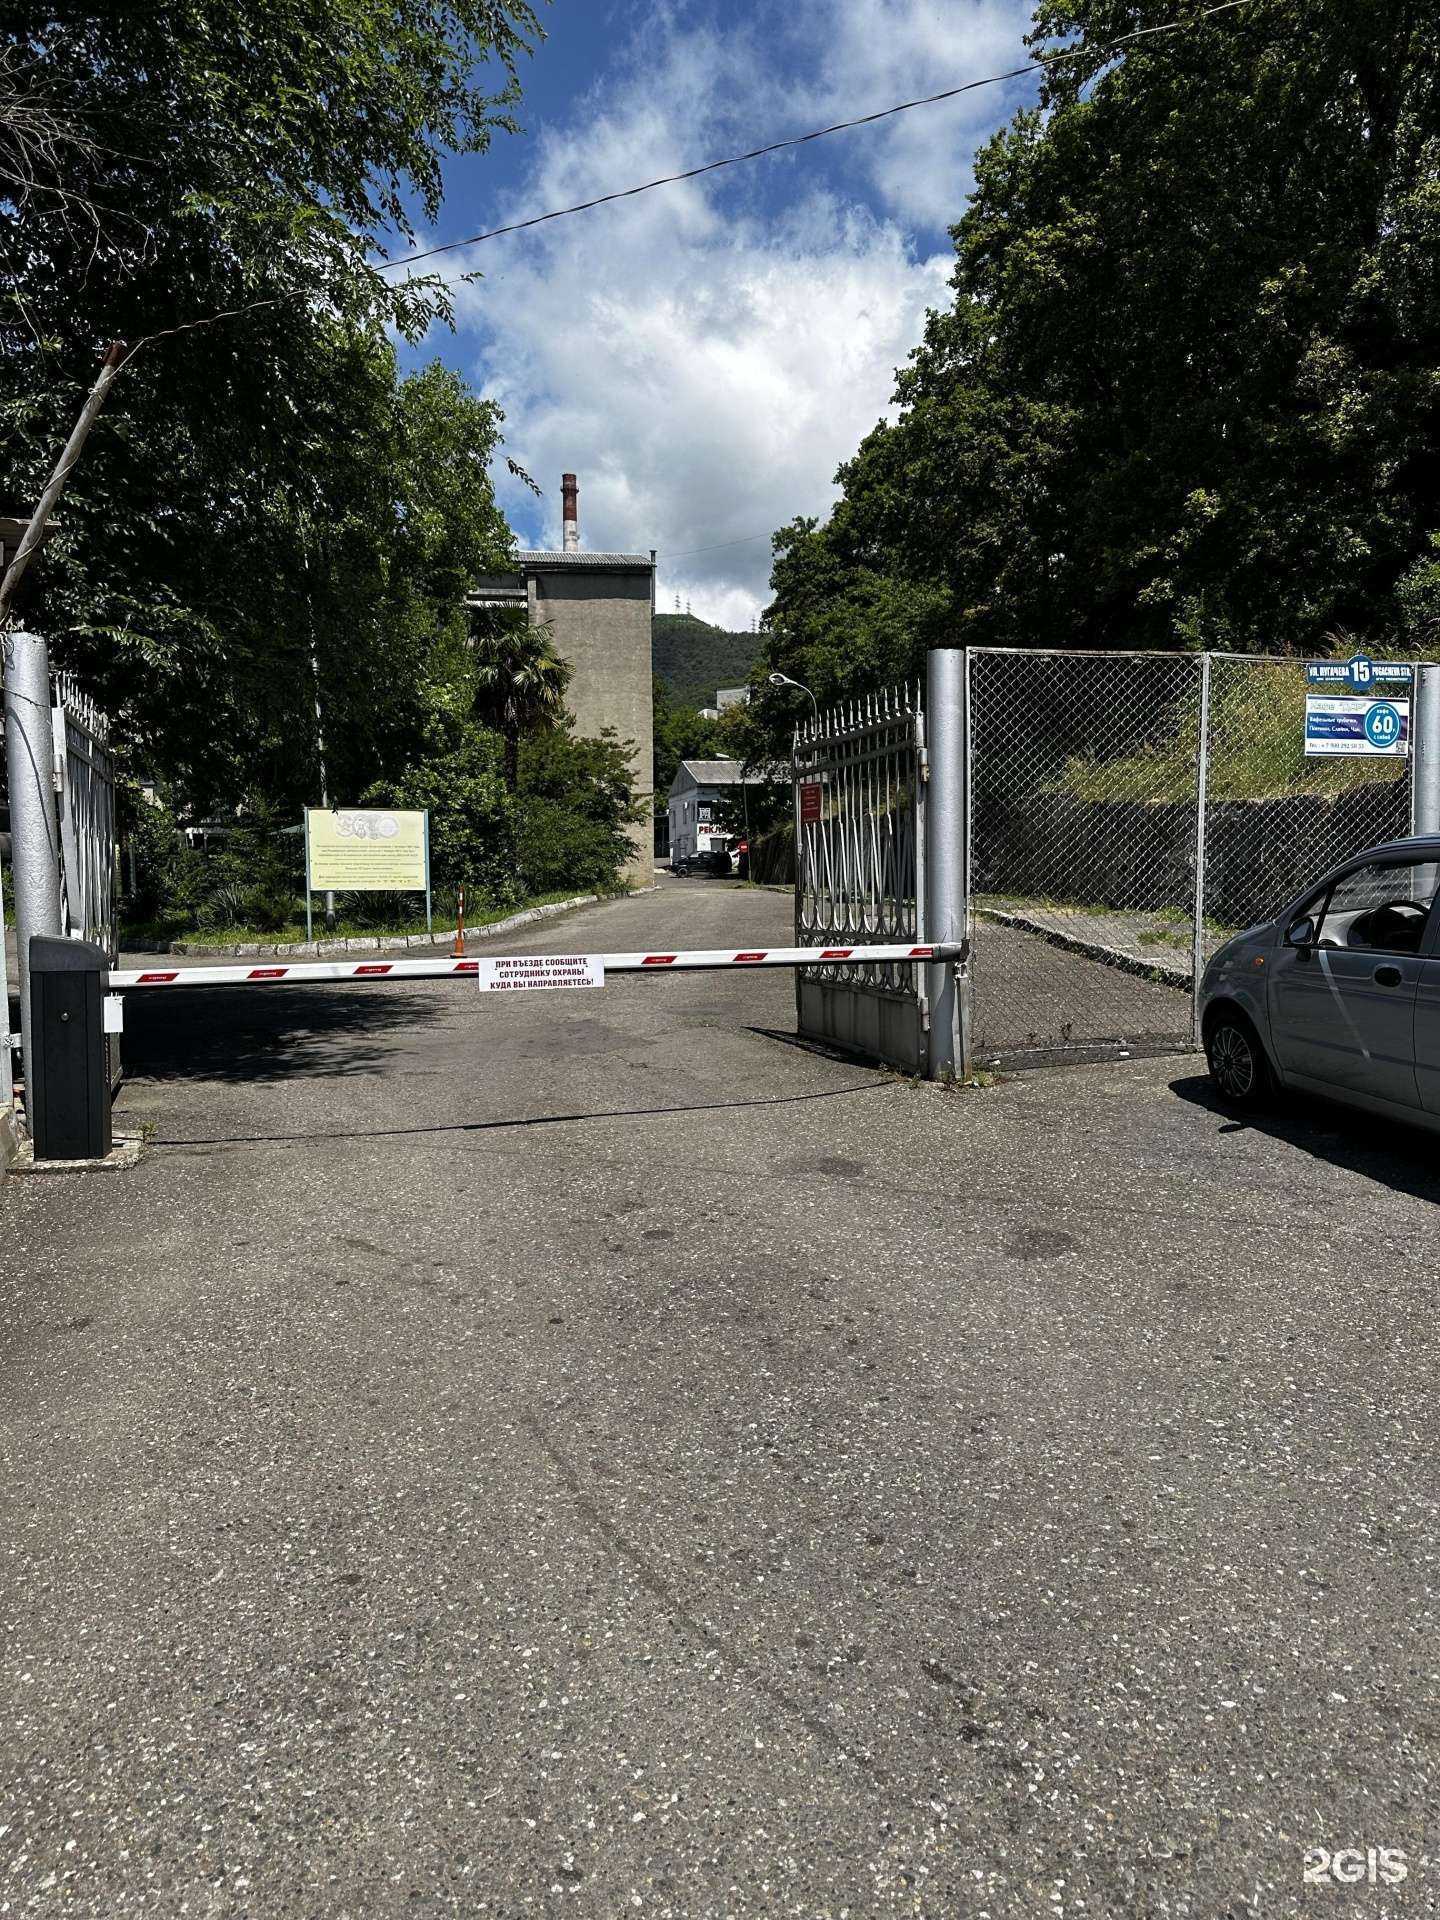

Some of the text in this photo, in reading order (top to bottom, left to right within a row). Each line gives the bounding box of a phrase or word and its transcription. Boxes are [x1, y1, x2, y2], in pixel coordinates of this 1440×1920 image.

[1320, 666, 1350, 677] ПУГАЧЕВА
[1351, 661, 1370, 682] 15
[1372, 715, 1393, 734] 60
[495, 957, 587, 968] ПРИ ВЪЕЗДЕ СООБЩИТЕ
[499, 968, 585, 979] СОТРУДНИКУ ОХРАНЫ
[490, 978, 594, 990] КУДА ВЫ НАПРАВЛЯЕТЕСЬ!
